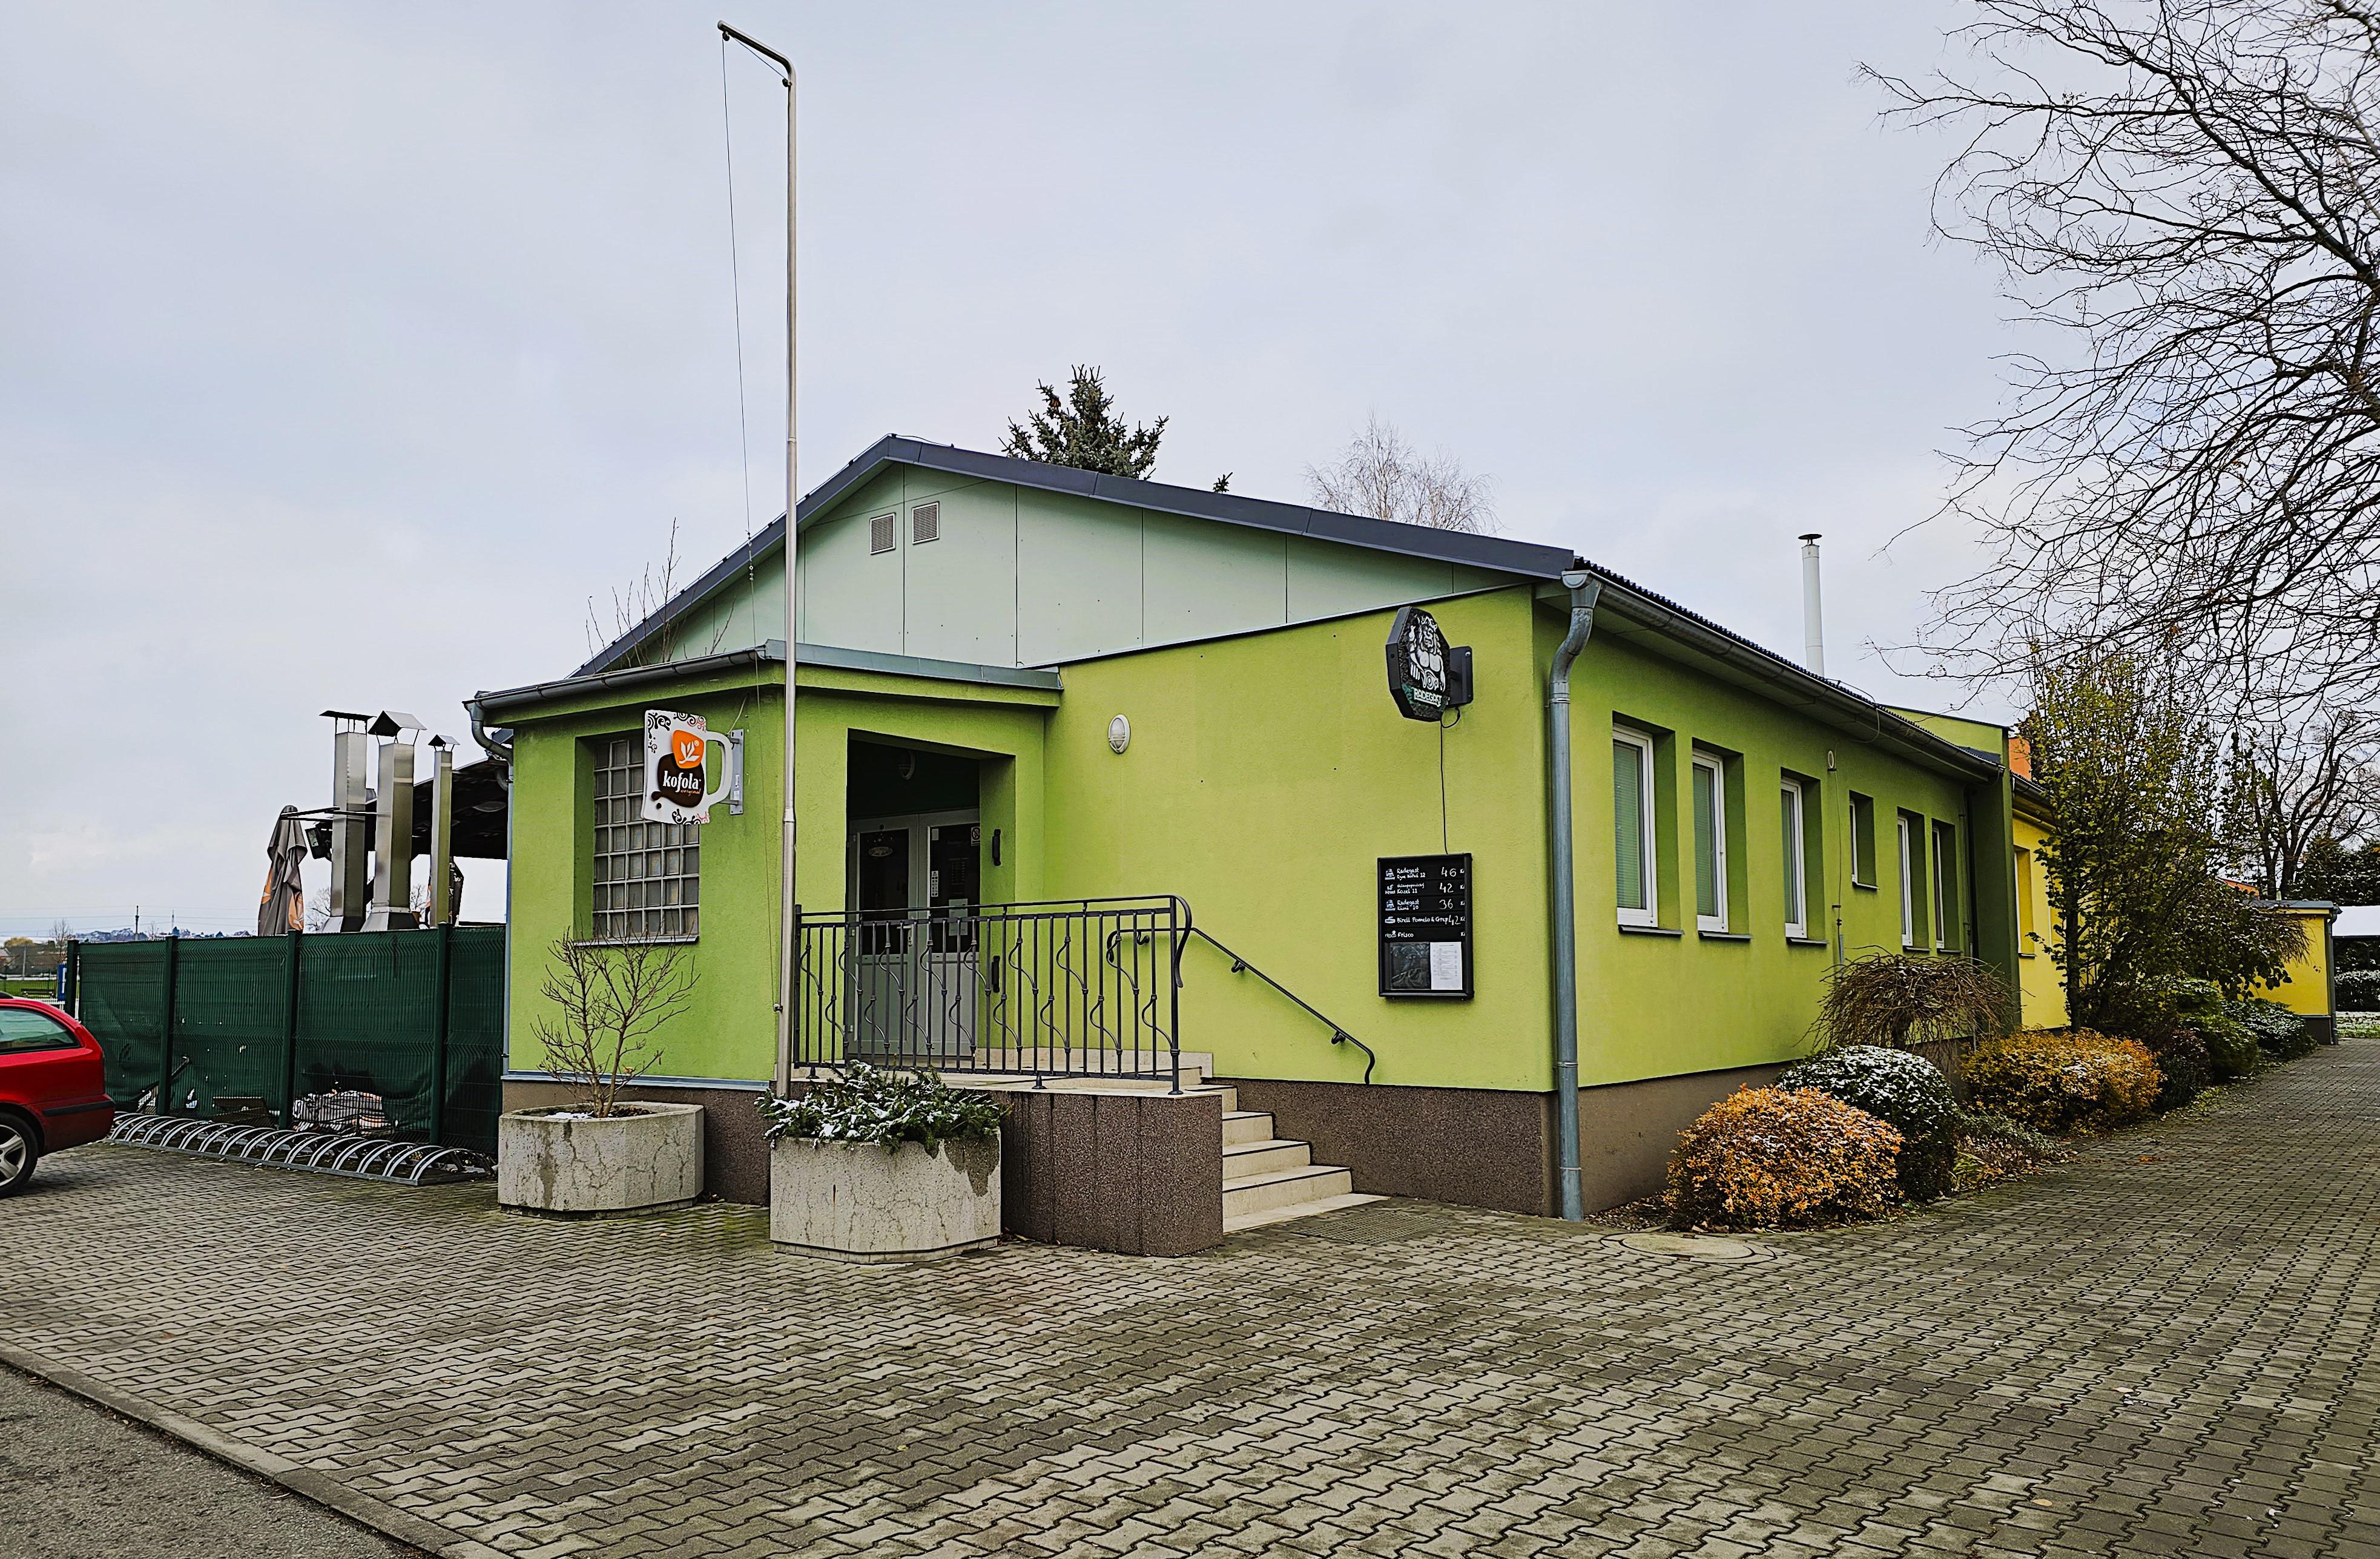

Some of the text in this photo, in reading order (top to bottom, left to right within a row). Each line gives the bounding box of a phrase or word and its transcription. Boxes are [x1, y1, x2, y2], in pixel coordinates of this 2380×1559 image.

[1414, 688, 1442, 707] RADEGAST
[662, 770, 699, 793] kofola
[681, 788, 701, 797] original
[1441, 867, 1456, 877] 46
[1439, 883, 1454, 893] 42
[1439, 898, 1454, 909] 36
[1435, 916, 1448, 925] Grep
[1448, 915, 1461, 926] 42
